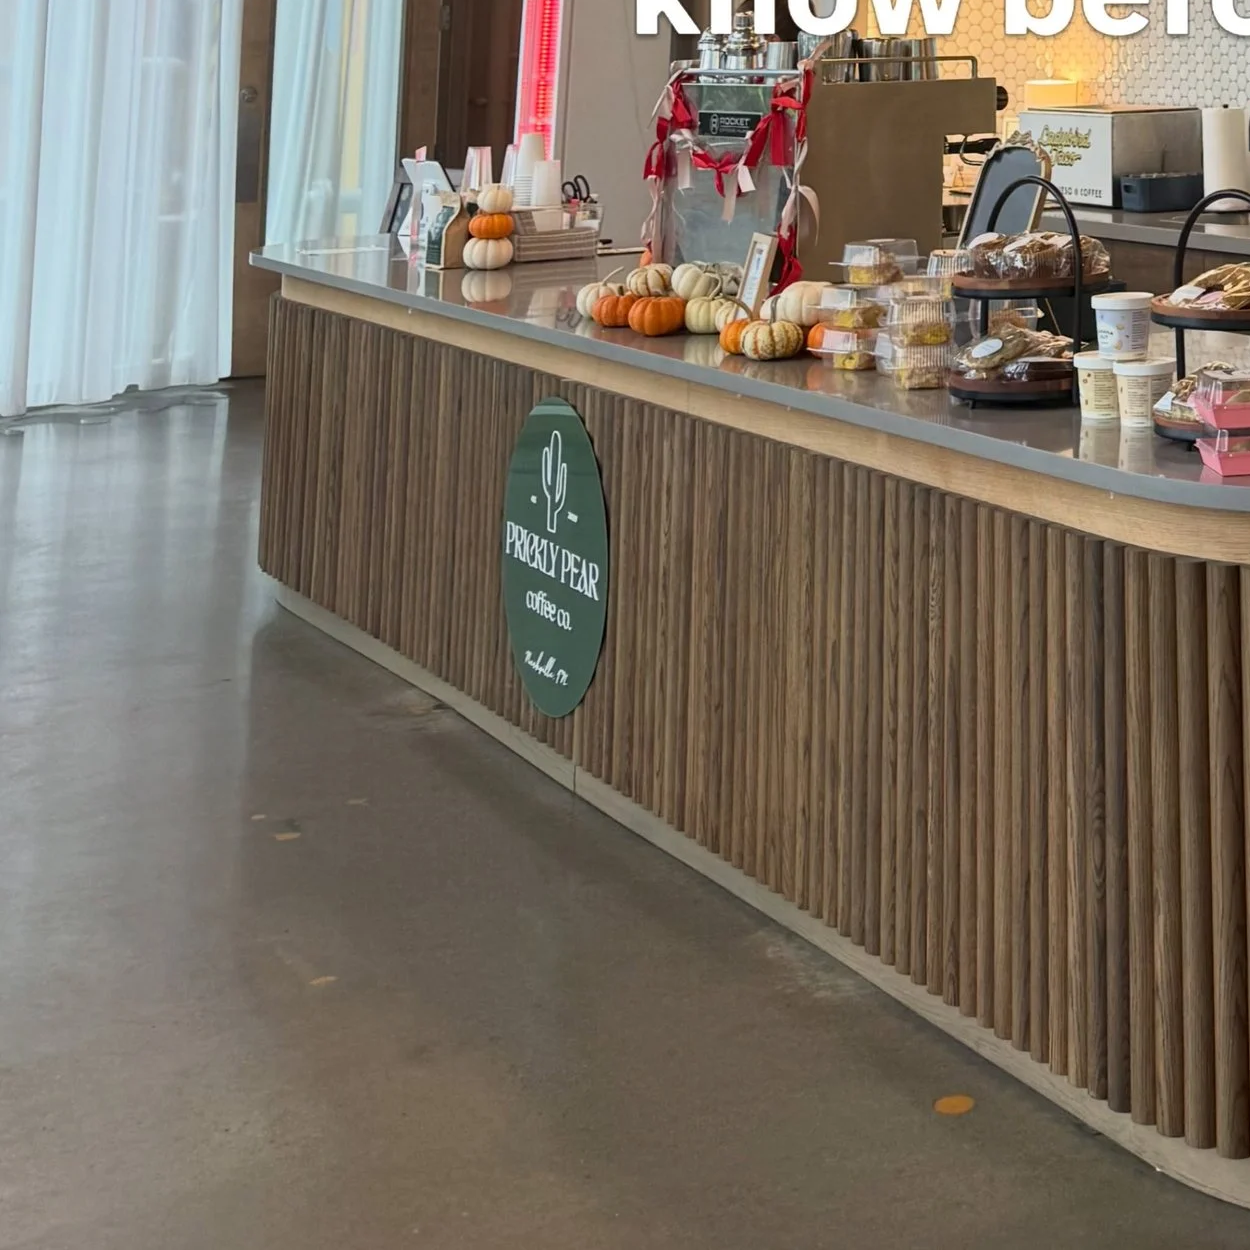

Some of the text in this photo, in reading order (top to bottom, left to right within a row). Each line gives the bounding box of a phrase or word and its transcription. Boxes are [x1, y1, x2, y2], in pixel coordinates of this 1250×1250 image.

[720, 117, 750, 126] ROCKET
[505, 520, 600, 601] PRICKLY PEAR
[526, 590, 572, 631] coffee co.
